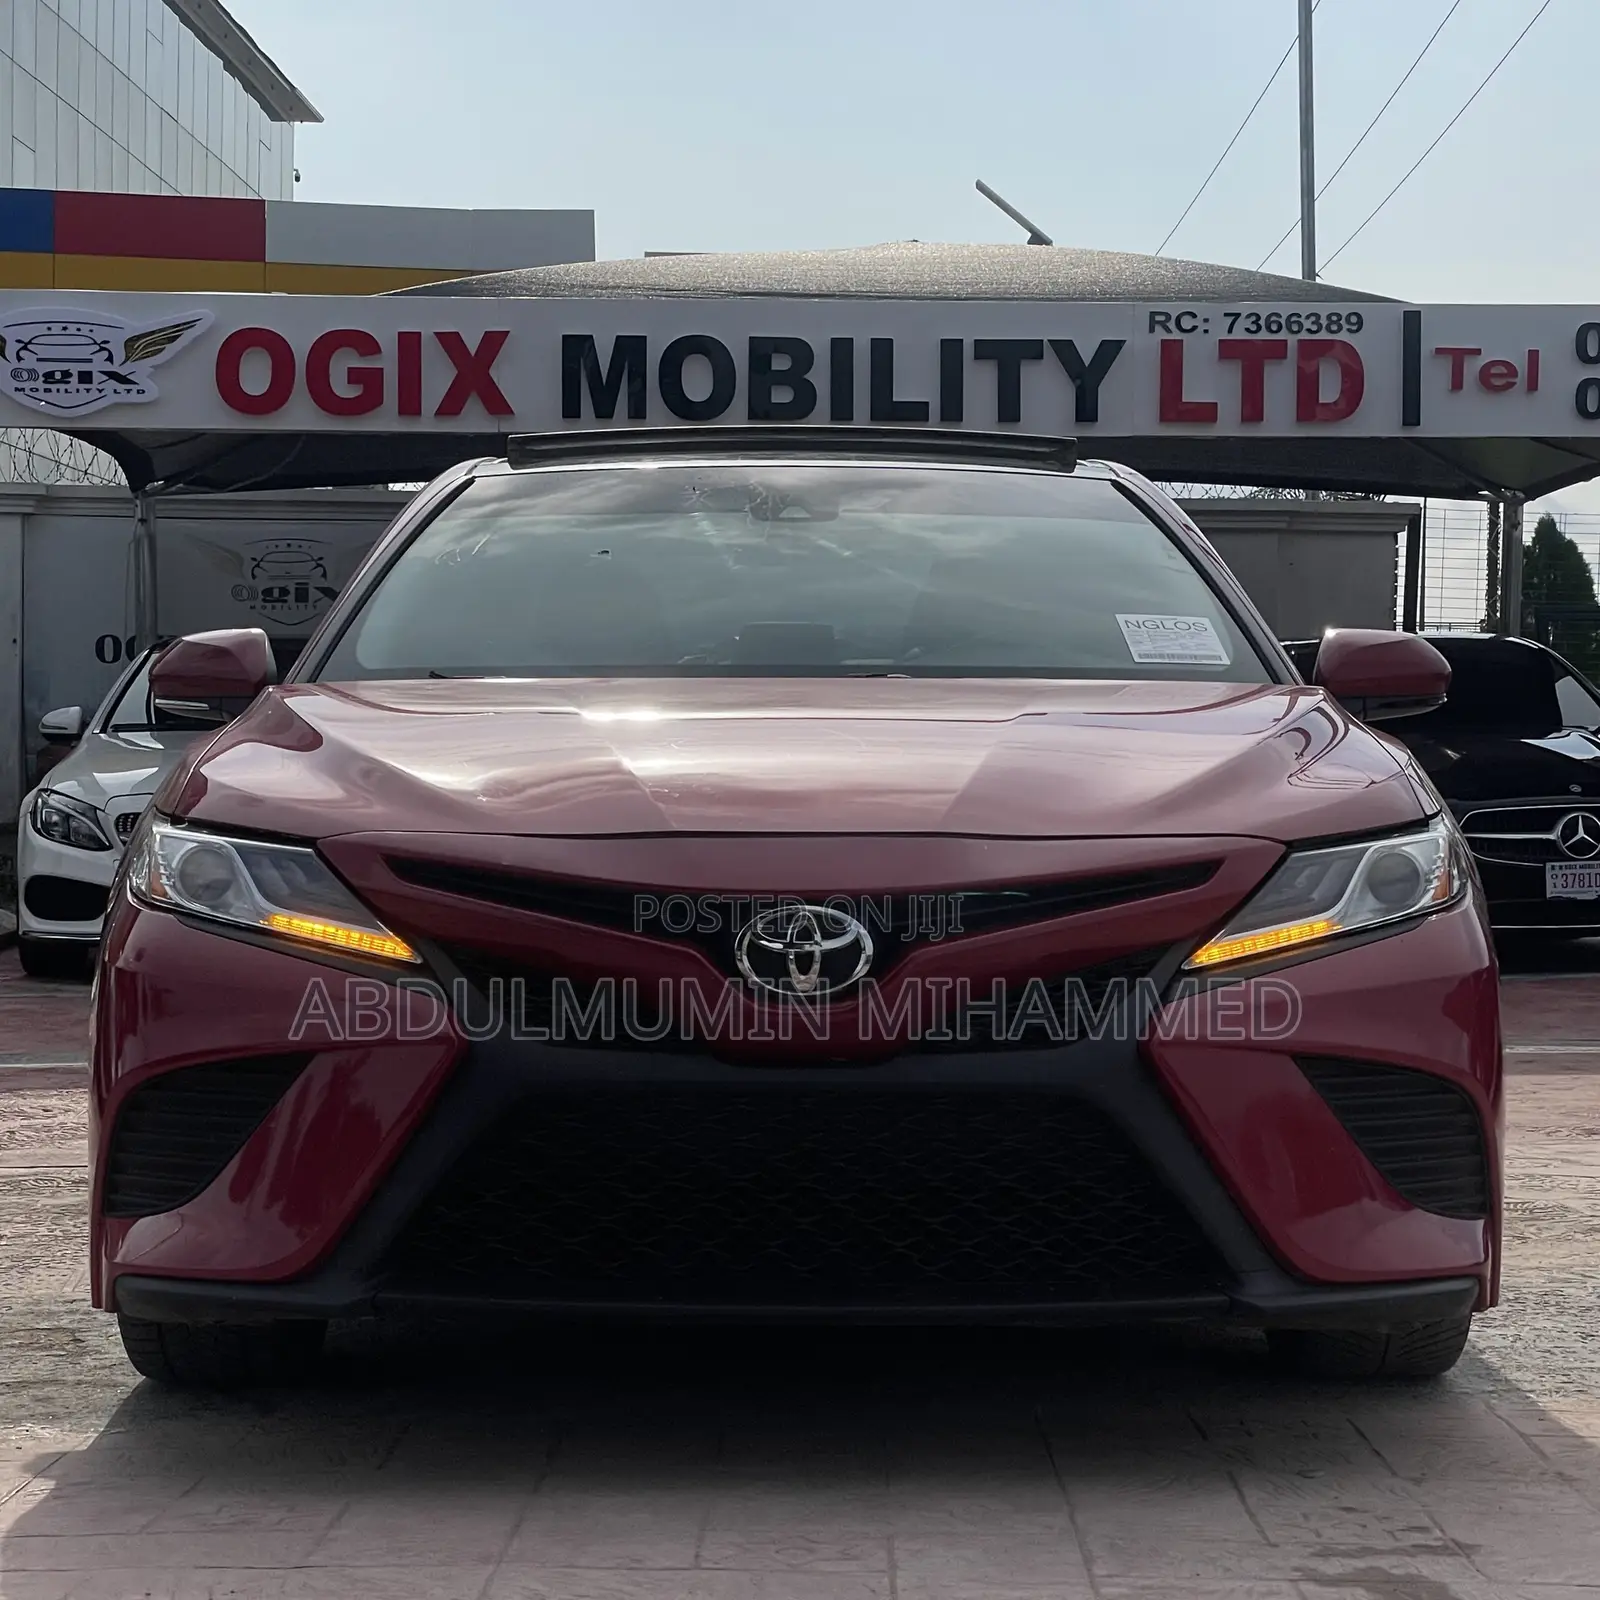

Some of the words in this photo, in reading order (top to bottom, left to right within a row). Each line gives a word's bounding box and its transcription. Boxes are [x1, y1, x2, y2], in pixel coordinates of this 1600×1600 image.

[1148, 311, 1210, 334] RC:
[1223, 311, 1364, 334] 7366389
[215, 327, 515, 416] OGIX
[561, 334, 1127, 422] MOBILITY
[1159, 339, 1365, 423] LTD
[1434, 347, 1540, 392] Tel
[14, 386, 106, 394] MOBILITY
[1124, 619, 1208, 632] NGLOS
